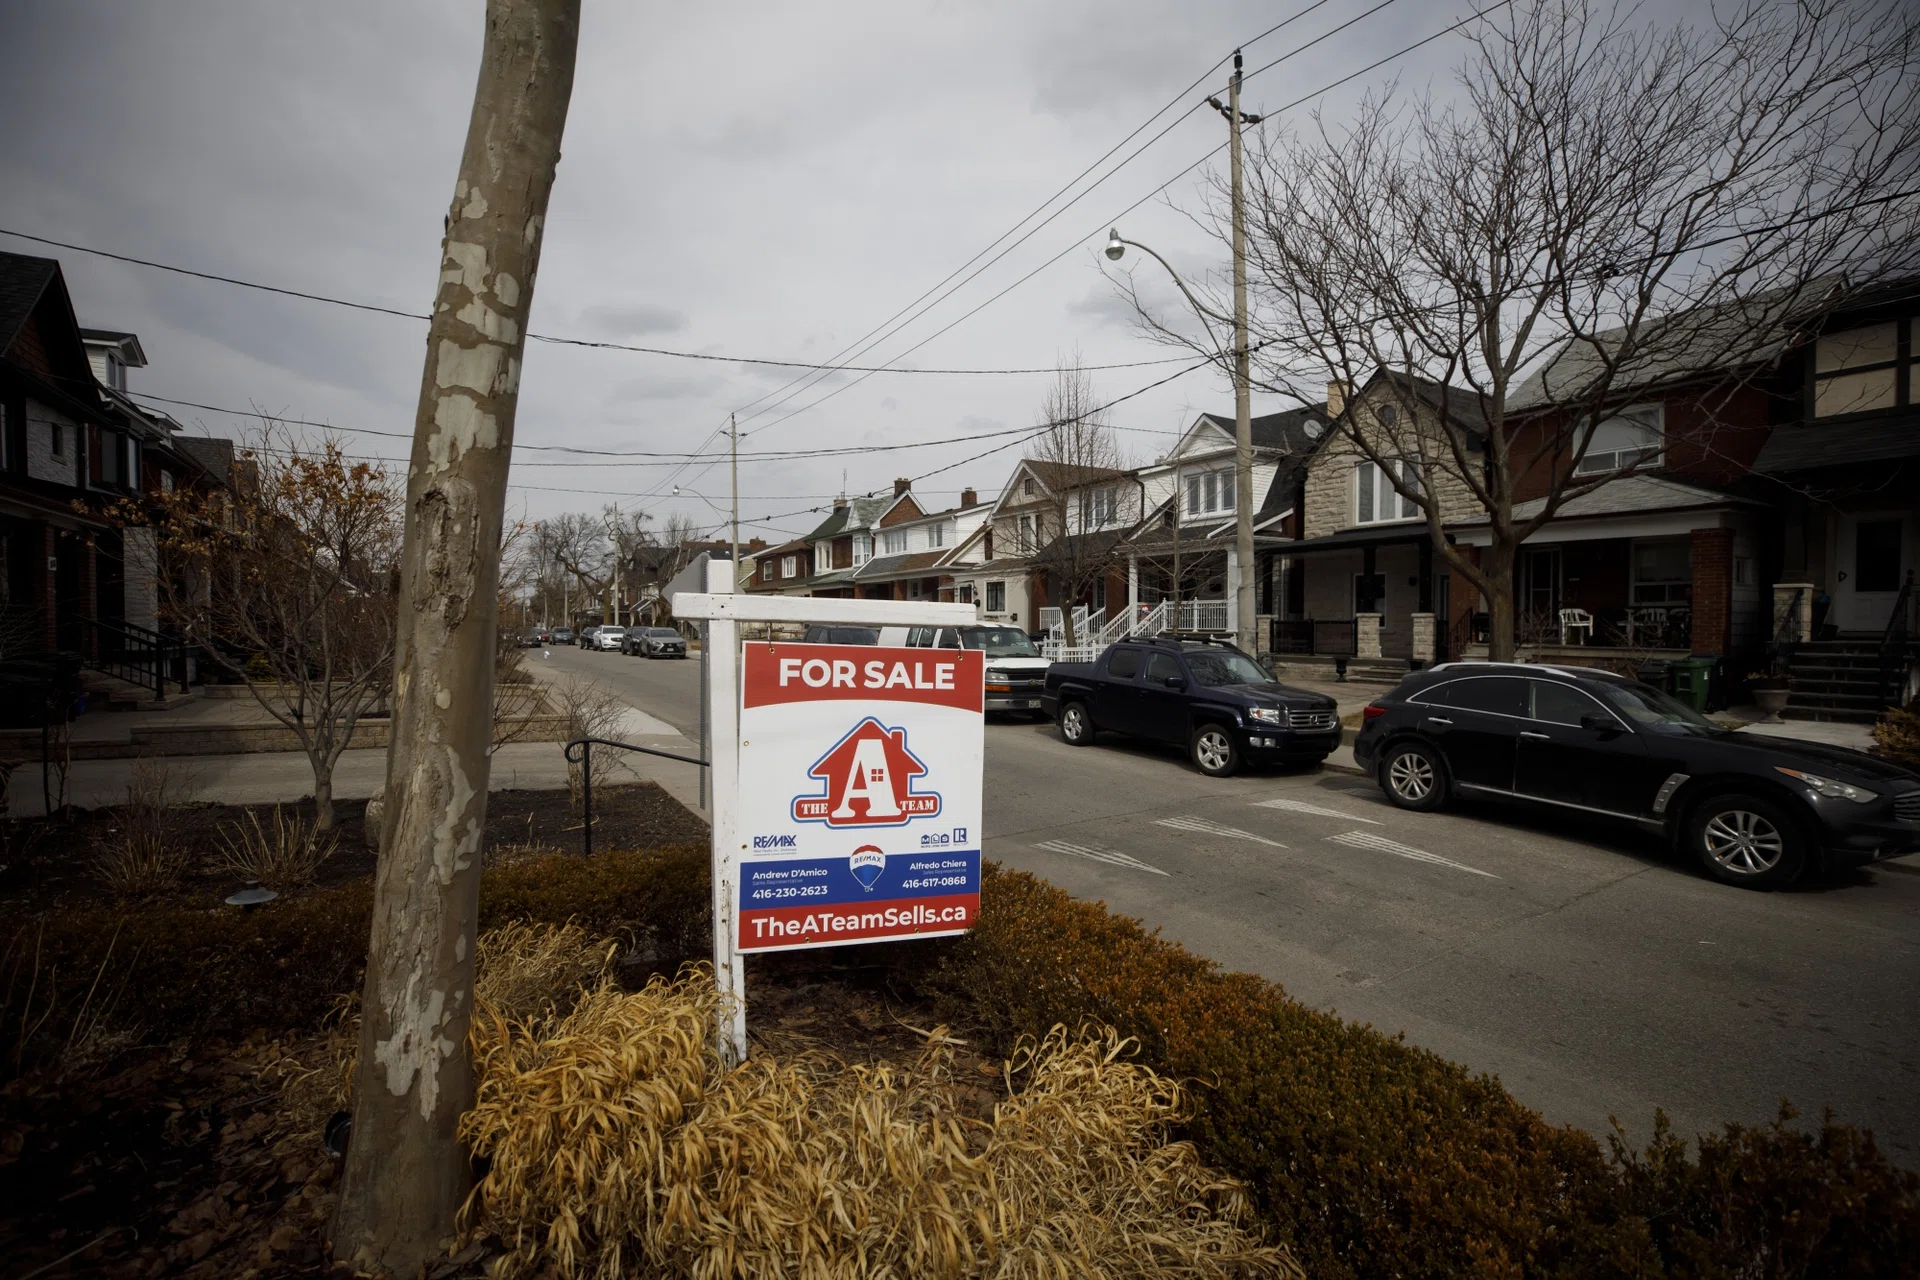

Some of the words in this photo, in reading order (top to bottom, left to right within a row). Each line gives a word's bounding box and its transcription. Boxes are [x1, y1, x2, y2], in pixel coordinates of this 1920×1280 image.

[779, 658, 857, 688] FOR
[863, 661, 955, 690] SALE
[801, 802, 829, 815] THE
[831, 738, 902, 819] A
[900, 799, 934, 811] TEAM
[753, 834, 797, 849] RE/MAX
[854, 855, 882, 864] RE/MAX
[909, 861, 940, 871] Alfredo
[941, 860, 967, 868] Chiera
[752, 871, 789, 880] Andrew
[791, 868, 828, 878] D'Amico
[902, 876, 967, 889] 416-617-0868
[752, 885, 828, 899] 416-230-2623
[751, 905, 967, 938] TheATeamSells.ca
